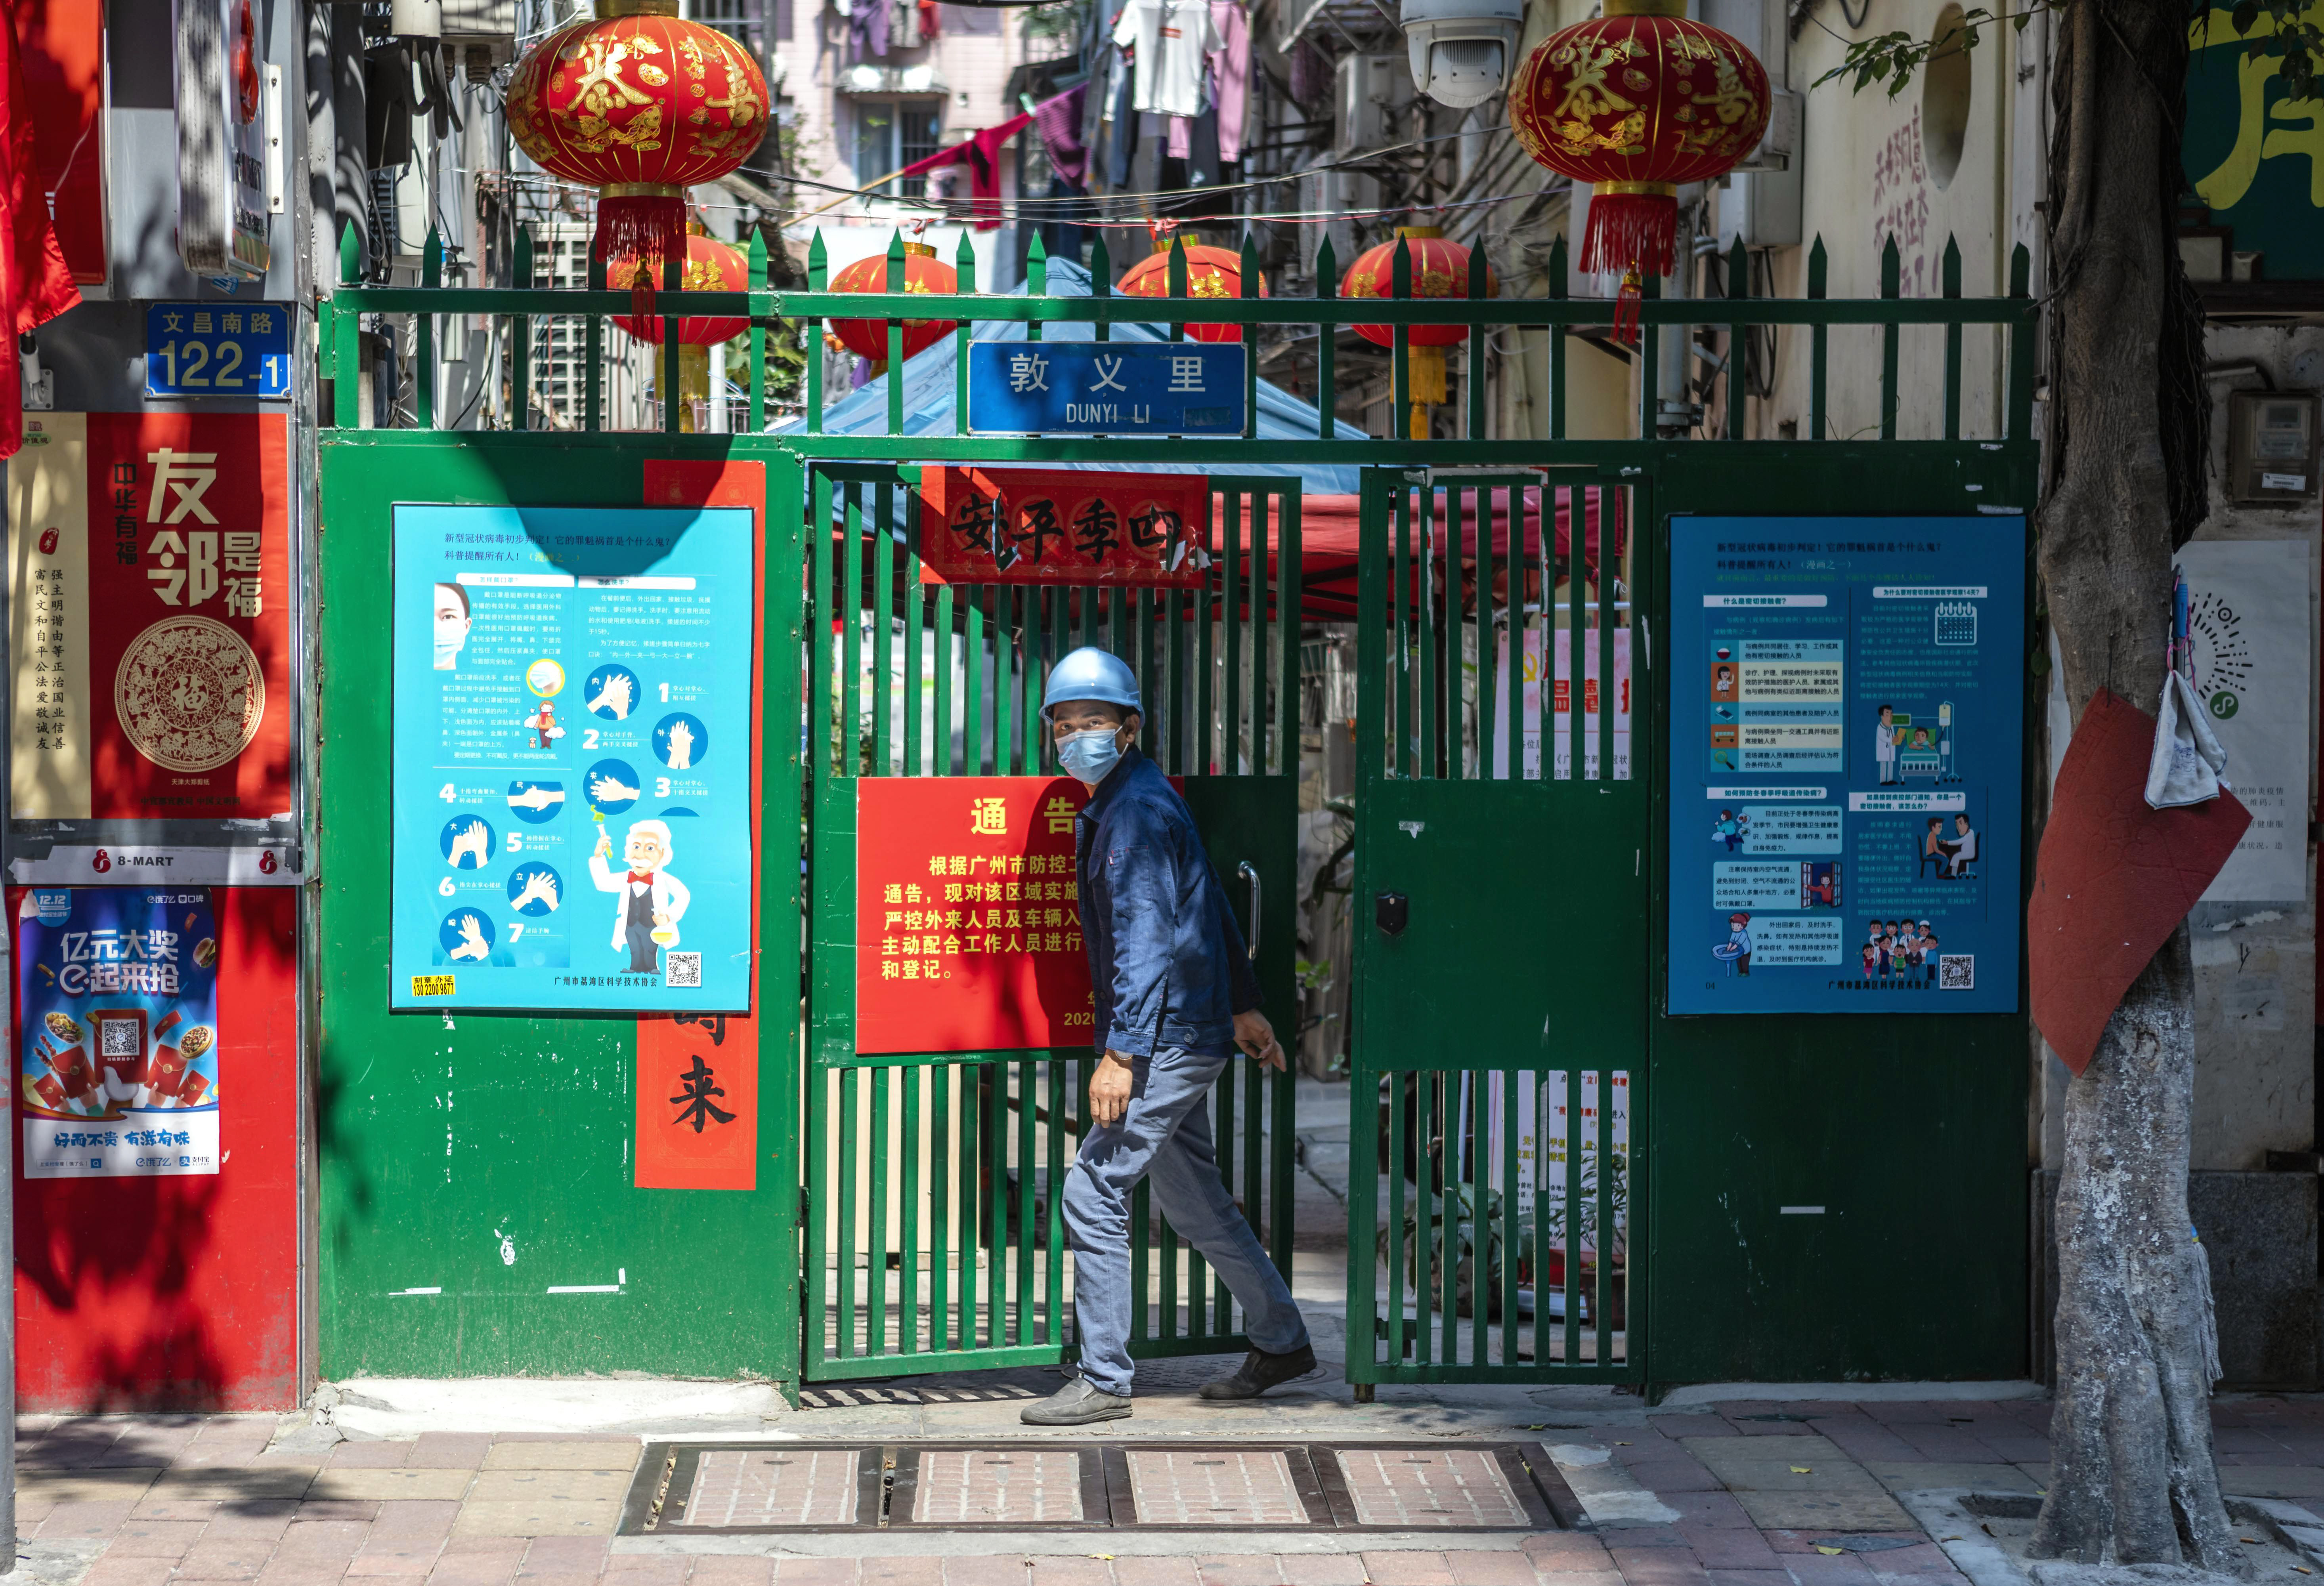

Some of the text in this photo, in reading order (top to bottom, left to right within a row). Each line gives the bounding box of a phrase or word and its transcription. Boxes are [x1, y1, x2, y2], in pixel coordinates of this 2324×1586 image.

[162, 312, 273, 334] 文昌南路
[159, 340, 277, 387] 122-1
[1010, 353, 1206, 392] 敦义里
[1066, 404, 1149, 423] DUNYI LI
[115, 462, 138, 565] 中华有福
[147, 448, 220, 607] 友邻
[445, 550, 519, 561] 科普提醒所有人！
[224, 532, 262, 618] 是福
[659, 683, 669, 702] 1
[583, 729, 599, 749] 2
[440, 784, 456, 803] 4
[654, 777, 671, 798] 3
[971, 797, 1077, 835] 通告
[507, 832, 522, 852] 5
[118, 857, 174, 867] 8-MART
[439, 877, 455, 896] 6
[884, 882, 1078, 904] 通告，现对该区域实施
[40, 895, 66, 905] 12.12
[884, 908, 1081, 931] 严控外来人员及车辆入
[508, 924, 524, 943] 7
[881, 932, 1082, 955] 主动配合工作人员进行
[60, 929, 179, 962] 亿元大奖
[881, 959, 951, 980] 和登记。
[413, 982, 454, 996] 130 2200 9877
[554, 977, 657, 987] 广州市荔湾区科学技术协会
[1829, 980, 1930, 990] 广州市荔湾区科学技术协会
[54, 1128, 190, 1147] 好而不贵 有滋有味
